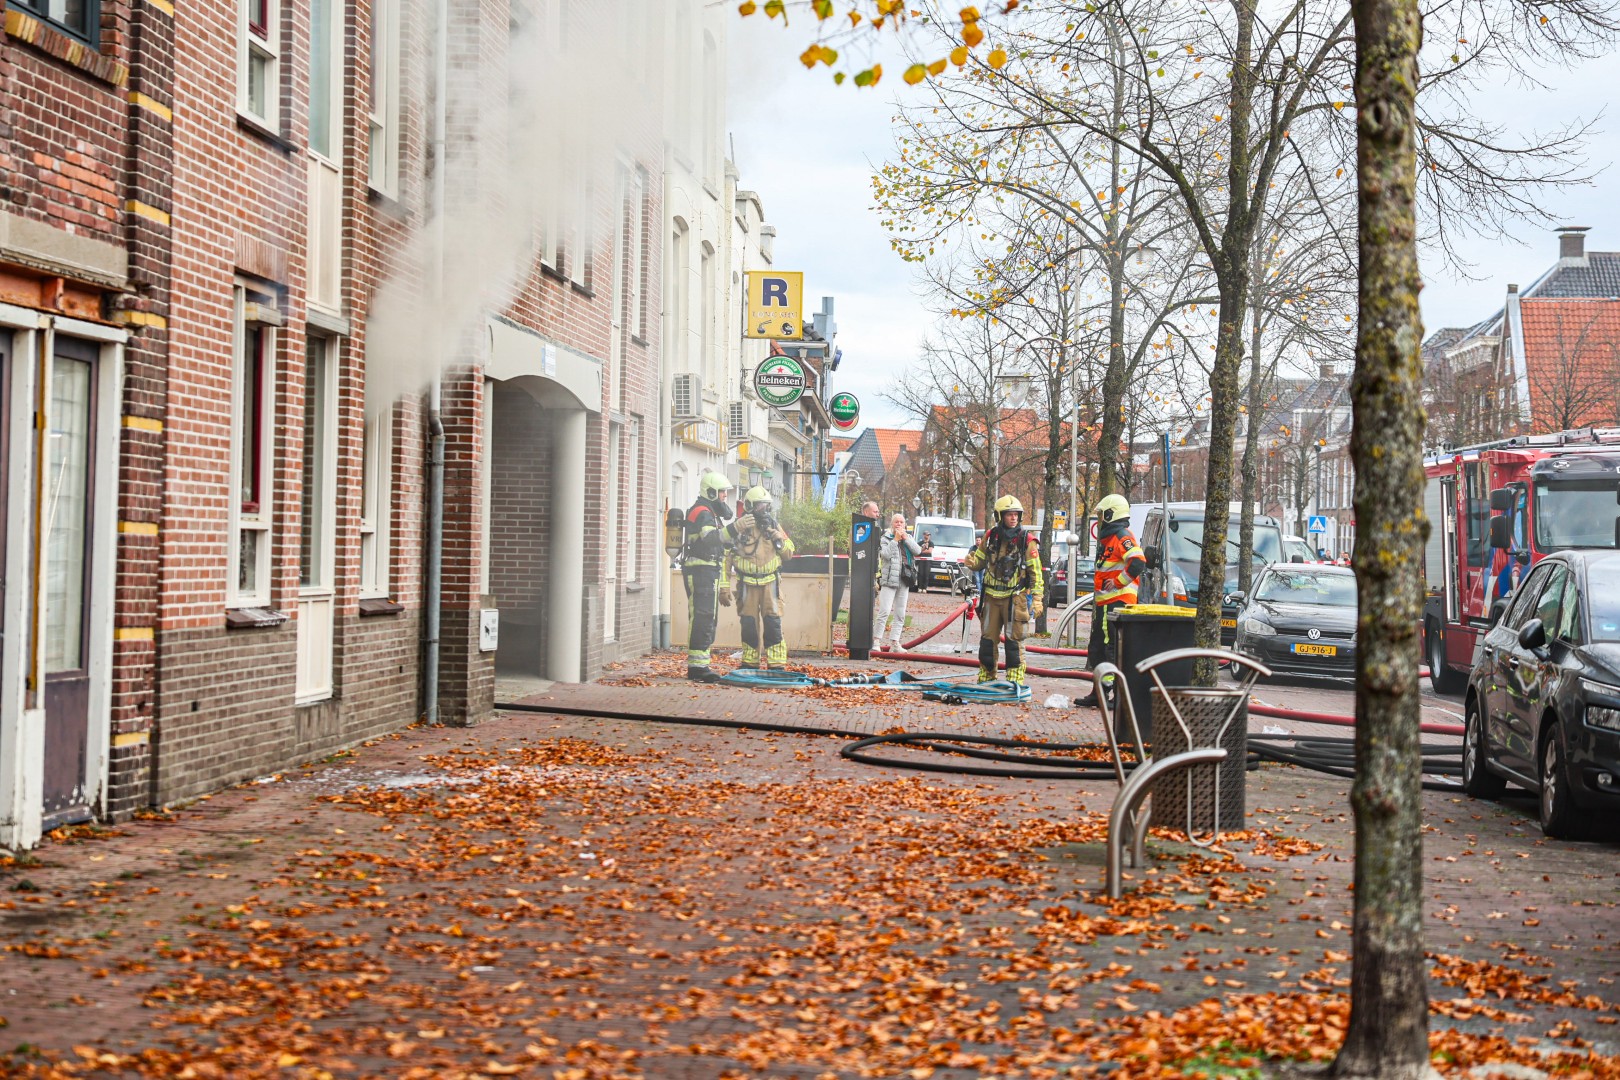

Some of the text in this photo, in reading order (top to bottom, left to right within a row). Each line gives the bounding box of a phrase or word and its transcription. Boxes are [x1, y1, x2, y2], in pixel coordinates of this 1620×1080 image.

[761, 277, 788, 307] R
[760, 375, 800, 386] Heineken
[1299, 645, 1332, 654] GJ-916-J
